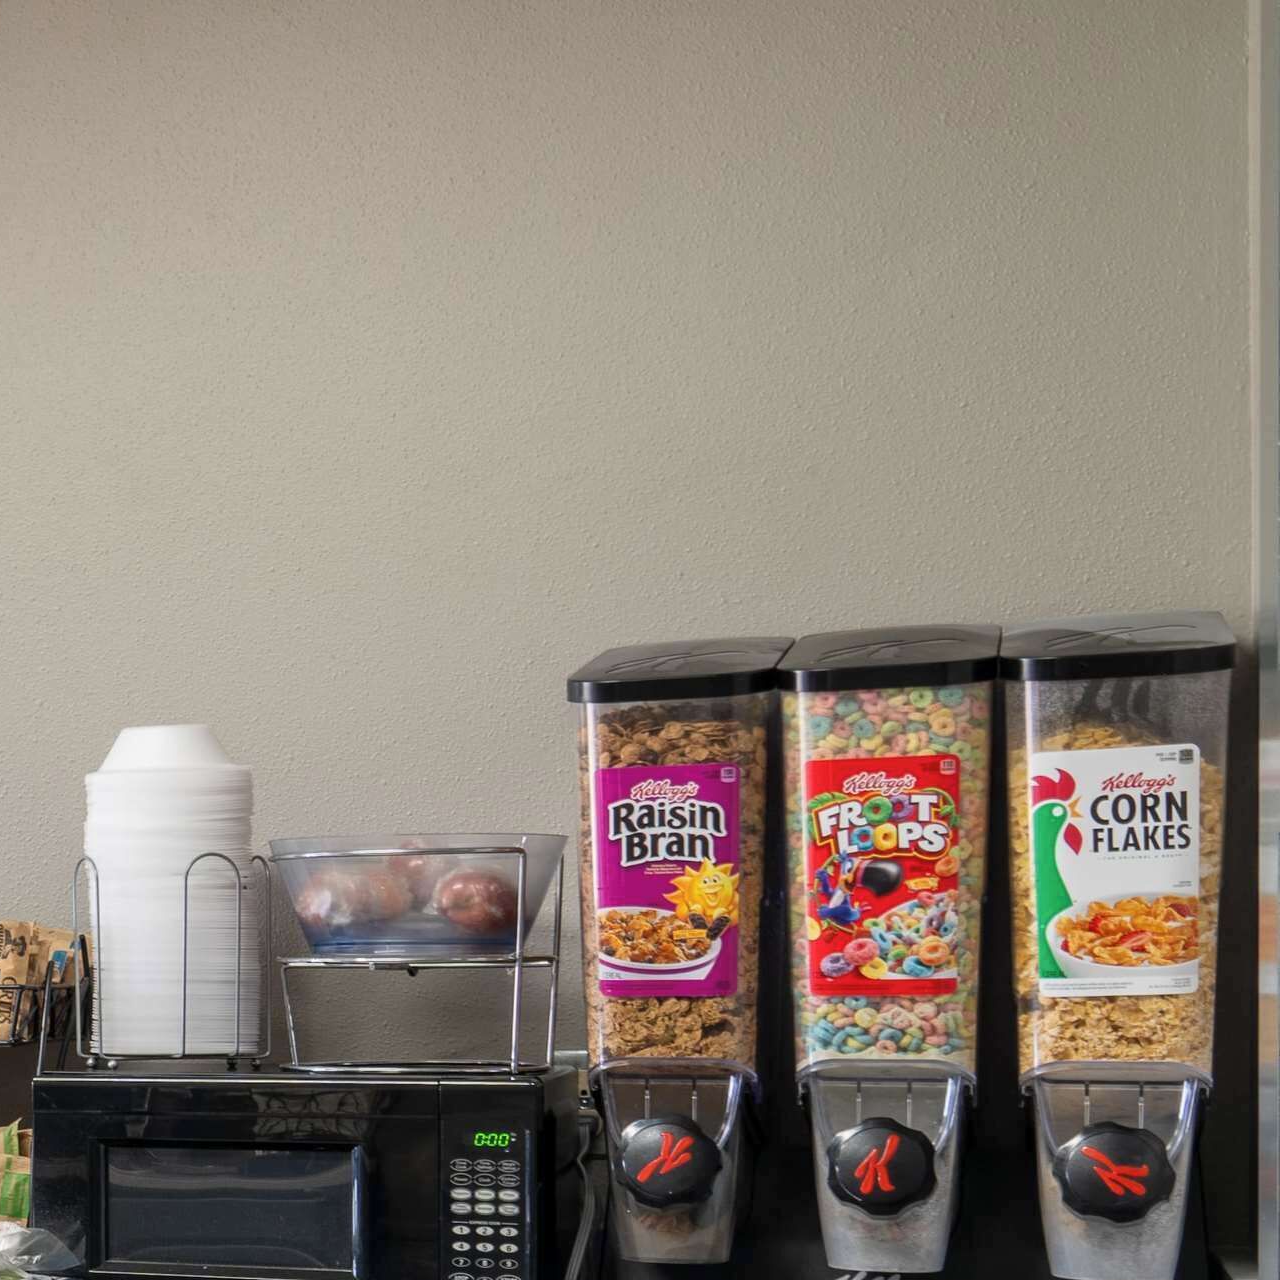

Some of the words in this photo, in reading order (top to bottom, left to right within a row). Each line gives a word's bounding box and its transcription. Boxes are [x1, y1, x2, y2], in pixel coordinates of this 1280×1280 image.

[631, 779, 699, 803] Kellogg's
[843, 772, 917, 795] Kellogg's
[1101, 772, 1177, 793] Kellogg's
[610, 799, 725, 838] Raisin
[818, 794, 938, 837] FROOT
[1090, 791, 1188, 825] CORN
[623, 831, 715, 865] Bran
[837, 821, 949, 854] LOOPS
[1092, 823, 1192, 853] FLAKES
[474, 1133, 510, 1147] 0:00
[636, 1132, 693, 1183] K
[853, 1134, 901, 1195] K
